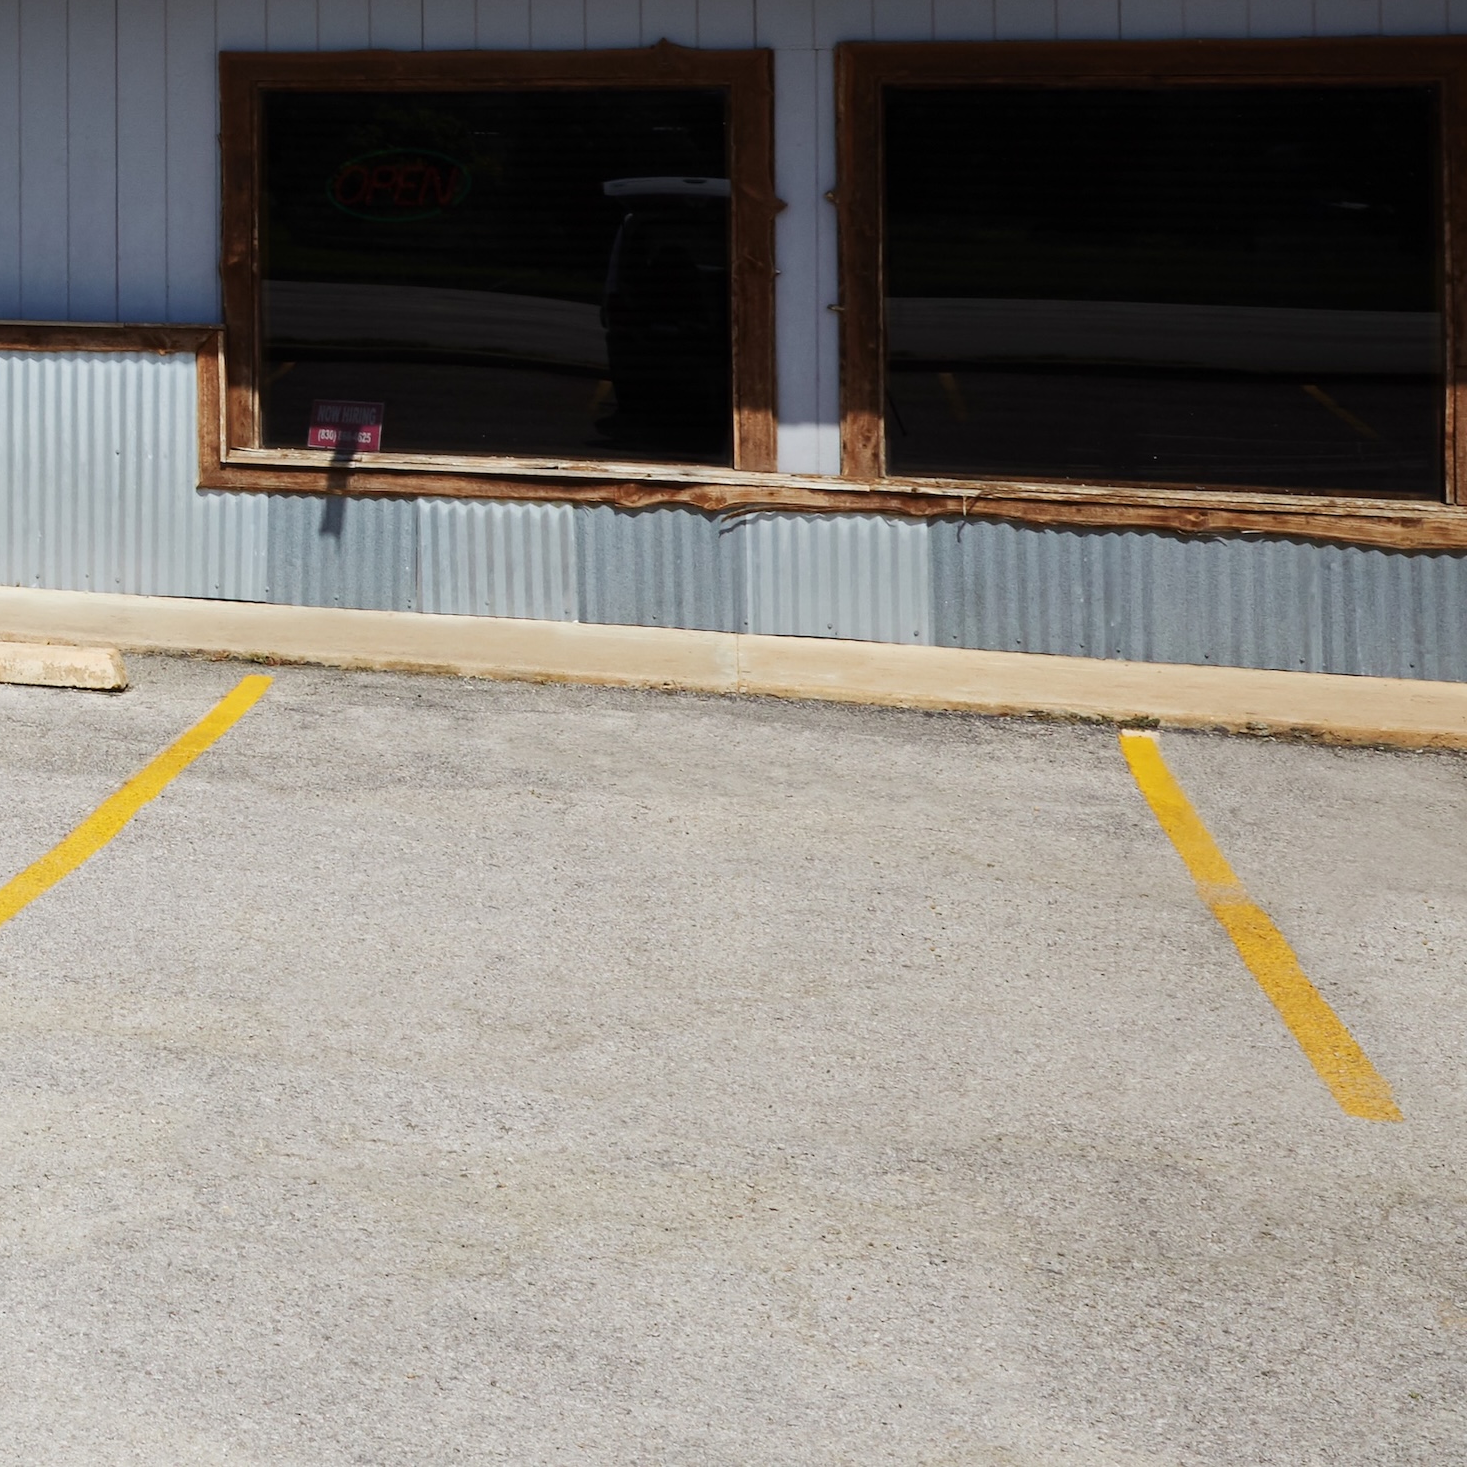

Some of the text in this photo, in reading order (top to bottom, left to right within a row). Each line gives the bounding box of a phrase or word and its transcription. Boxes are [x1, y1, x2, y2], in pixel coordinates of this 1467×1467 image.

[334, 163, 460, 207] OPEN
[317, 405, 377, 425] NOW HIRING
